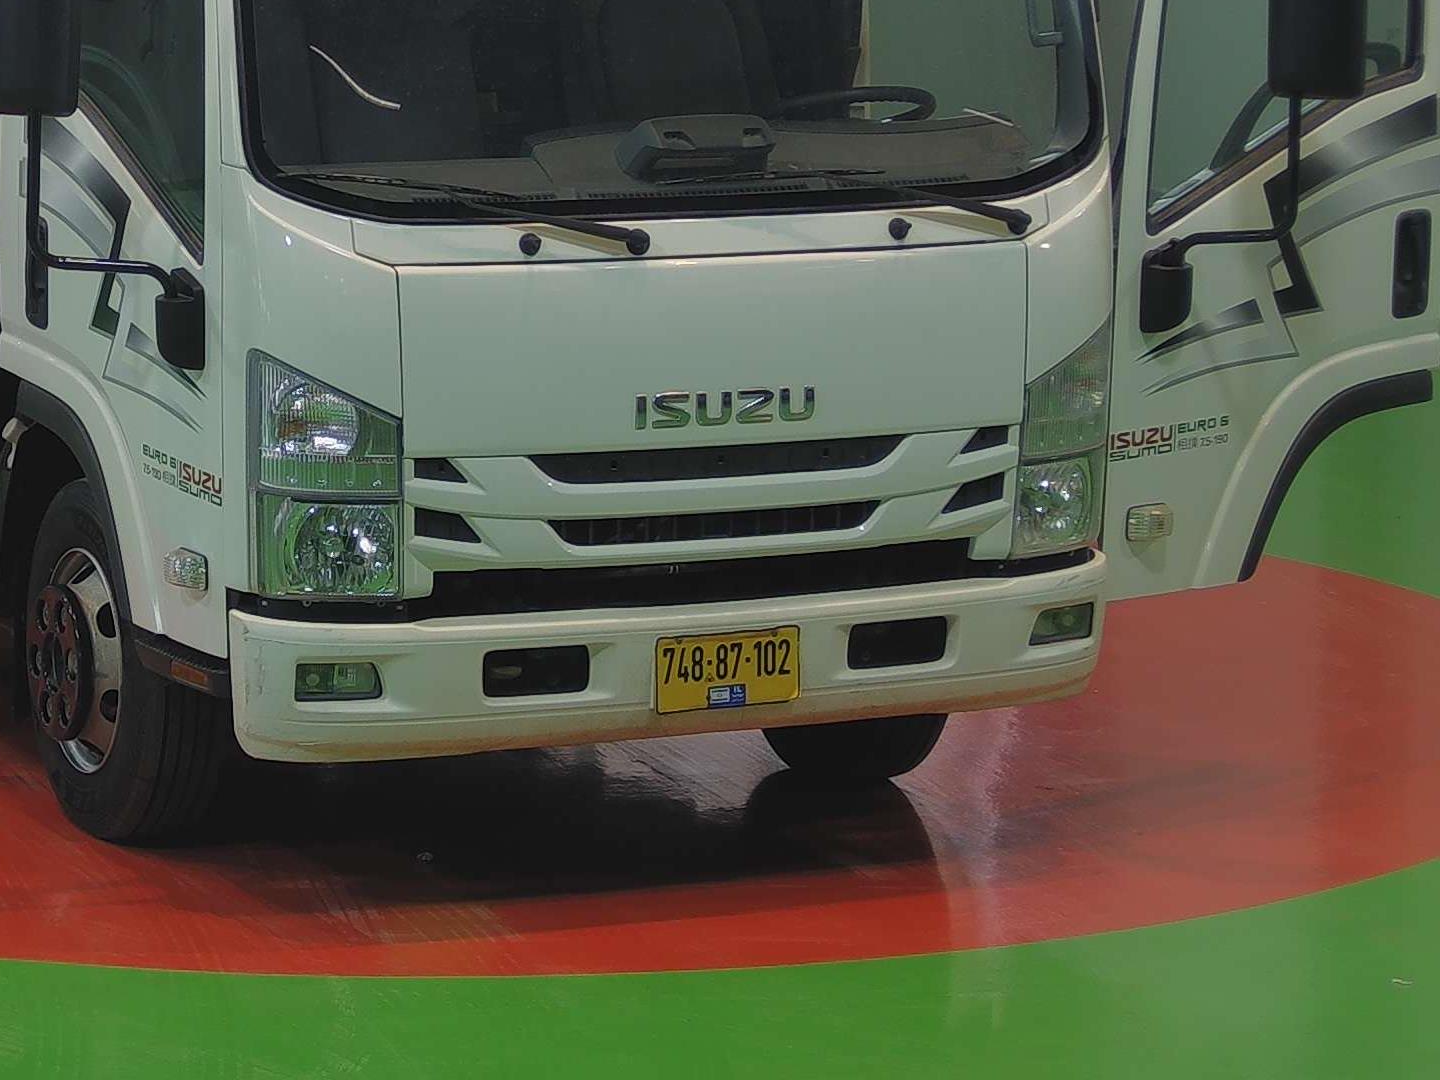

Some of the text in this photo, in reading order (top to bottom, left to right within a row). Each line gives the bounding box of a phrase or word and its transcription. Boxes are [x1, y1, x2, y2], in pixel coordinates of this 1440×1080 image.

[635, 384, 815, 431] ISUZU
[1110, 425, 1174, 450] ISUZU
[1177, 417, 1217, 434] EURO
[142, 444, 168, 465] EURO
[1109, 443, 1173, 462] SUMO
[179, 460, 222, 494] ISUZU
[178, 480, 223, 507] SUMO
